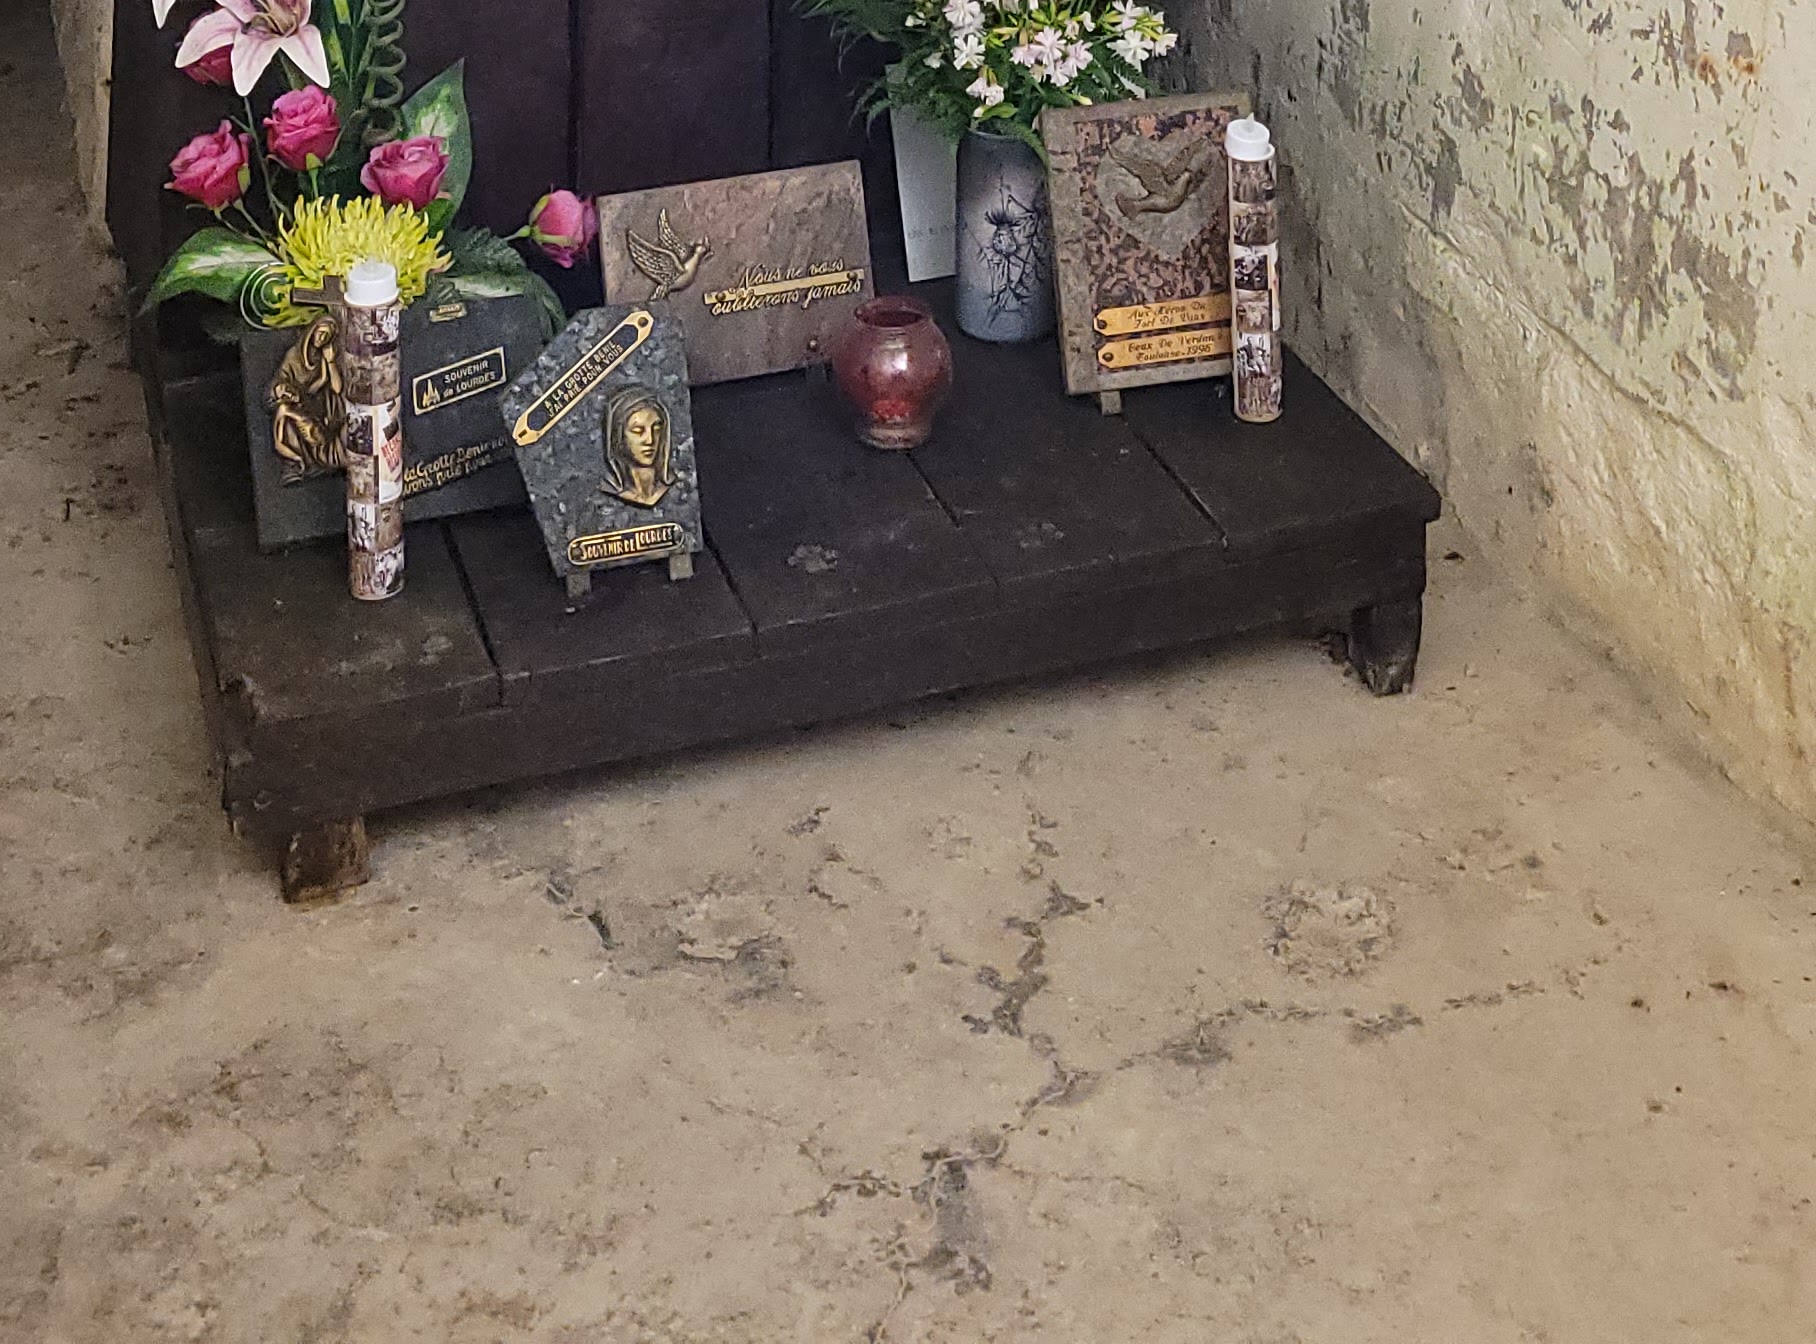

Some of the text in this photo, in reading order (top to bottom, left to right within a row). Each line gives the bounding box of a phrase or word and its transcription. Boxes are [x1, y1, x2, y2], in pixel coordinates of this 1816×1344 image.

[737, 258, 844, 290] Nous ne vous
[712, 278, 862, 316] oublierons jamais
[444, 359, 489, 384] SOUVENIR
[552, 388, 565, 401] LA
[564, 360, 594, 390] GROTTE
[582, 364, 603, 385] POUR
[603, 344, 624, 365] VOUS
[443, 370, 496, 398] de LOURDES
[402, 476, 434, 496] vons
[580, 527, 673, 560] SOUVENIR DE LOURDES
